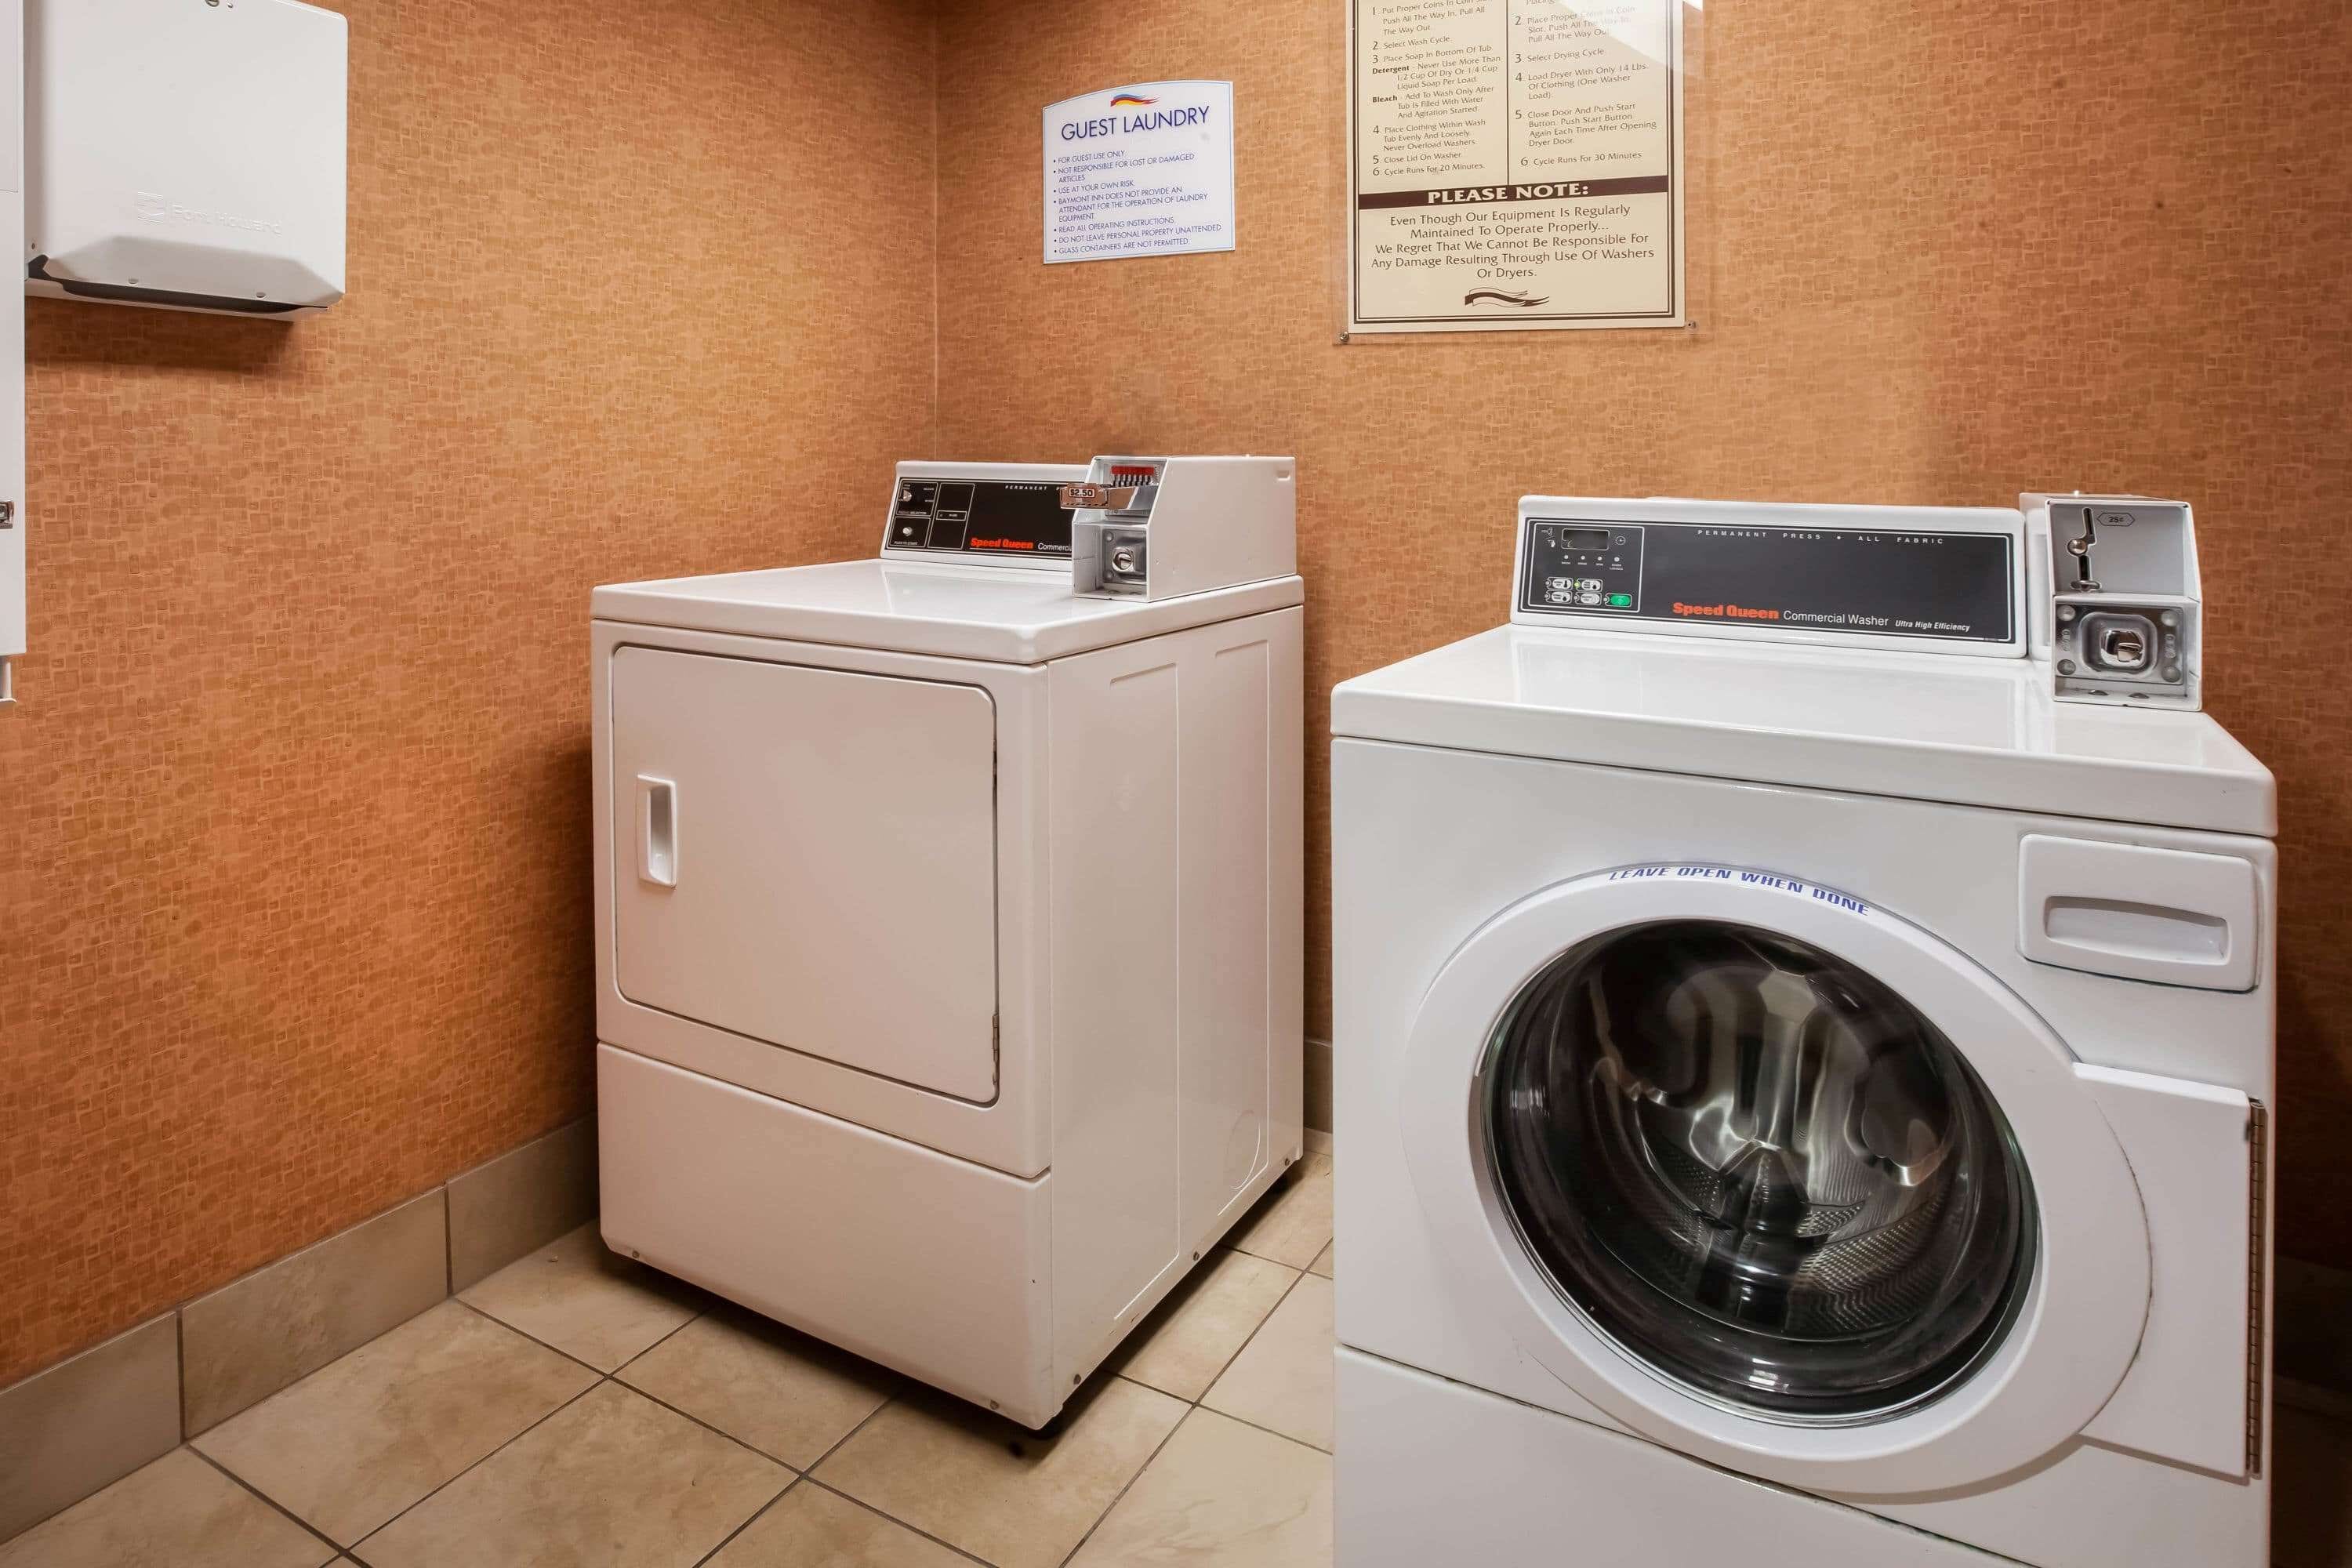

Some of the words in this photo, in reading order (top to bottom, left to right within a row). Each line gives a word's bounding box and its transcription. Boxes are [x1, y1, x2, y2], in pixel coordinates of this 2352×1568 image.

[1383, 40, 1406, 49] Select
[1408, 37, 1428, 46] Wash
[1527, 53, 1551, 62] Select
[1554, 51, 1580, 59] Drying
[1372, 65, 1409, 74] Detergent
[1528, 72, 1548, 80] Load
[1574, 67, 1593, 76] With
[1397, 82, 1420, 90] Liquid
[1541, 80, 1575, 89] Clothing
[1600, 74, 1631, 83] Washer
[1594, 104, 1614, 112] Push
[1616, 102, 1636, 110] Start
[1061, 117, 1117, 140] GUEST
[1124, 106, 1209, 133] LAUNDRY
[1529, 129, 1551, 138] Again
[1620, 121, 1657, 131] Opening
[1407, 141, 1442, 149] Overload
[1072, 154, 1091, 162] GUEST
[1107, 150, 1125, 158] ONLY
[1533, 157, 1555, 166] Cycle
[1074, 162, 1113, 172] RESPONSIBLE
[1159, 154, 1195, 164] DAMAGED
[1059, 174, 1085, 183] ARTICLES
[1384, 168, 1404, 176] Cycle
[1100, 181, 1119, 189] OWN
[1059, 195, 1090, 204] BAYMONT
[1141, 187, 1169, 196] PROVIDE
[1428, 188, 1508, 203] PLEASE
[1516, 183, 1589, 199] NOTE:
[1059, 204, 1096, 213] ATTENDANT
[1125, 197, 1163, 207] OPERATION
[1176, 193, 1208, 202] LAUNDRY
[1059, 213, 1094, 222] EQUIPMENT
[1390, 216, 1416, 226] Even
[1420, 213, 1461, 225] Though
[1466, 212, 1487, 222] Our
[1492, 208, 1556, 222] Equipment
[1560, 208, 1570, 217] Is
[1574, 204, 1630, 218] Regularly
[1088, 220, 1125, 230] OPERATING
[1126, 215, 1174, 226] INSTRUCTIONS
[1107, 230, 1140, 239] PERSONAL
[1142, 228, 1173, 237] PROPERTY
[1175, 224, 1221, 234] UNATTENDED
[1410, 226, 1474, 239] Maintained
[1478, 226, 1491, 235] To
[1495, 224, 1544, 236] Operate
[1548, 220, 1609, 233] Properly...
[1080, 243, 1121, 252] CONTAINERS
[1154, 238, 1188, 246] PERMITTED
[1375, 244, 1393, 254] We
[1397, 242, 1432, 254] Regret
[1436, 241, 1461, 251] That
[1464, 241, 1483, 250] We
[1486, 238, 1528, 249] Cannot
[1533, 238, 1548, 247] Be
[1553, 235, 1626, 248] Responsible
[1631, 234, 1649, 243] For
[1371, 258, 1392, 269] Any
[1395, 258, 1442, 268] Damage
[1446, 254, 1498, 265] Resulting
[1502, 252, 1550, 263] Through
[1555, 251, 1577, 260] Use
[1582, 250, 1598, 259] Of
[1601, 248, 1655, 259] Washers
[1477, 269, 1491, 278] Or
[1496, 268, 1537, 279] Dryers.
[1698, 529, 1767, 538] PERMANENT
[970, 538, 1001, 547] Speed
[1002, 539, 1033, 549] Queen
[1672, 602, 1724, 617] Speed
[1726, 604, 1779, 620] Queen
[1783, 609, 1845, 624] Commercial
[1848, 613, 1889, 627] Washer
[1895, 619, 1913, 628] Ultra
[1914, 621, 1932, 629] High
[1933, 622, 1970, 633] Efficiency
[1609, 866, 1670, 880] LEAVE
[1676, 867, 1732, 879] OPEN
[1740, 872, 1804, 894] WHEN
[1813, 888, 1870, 916] DONE
